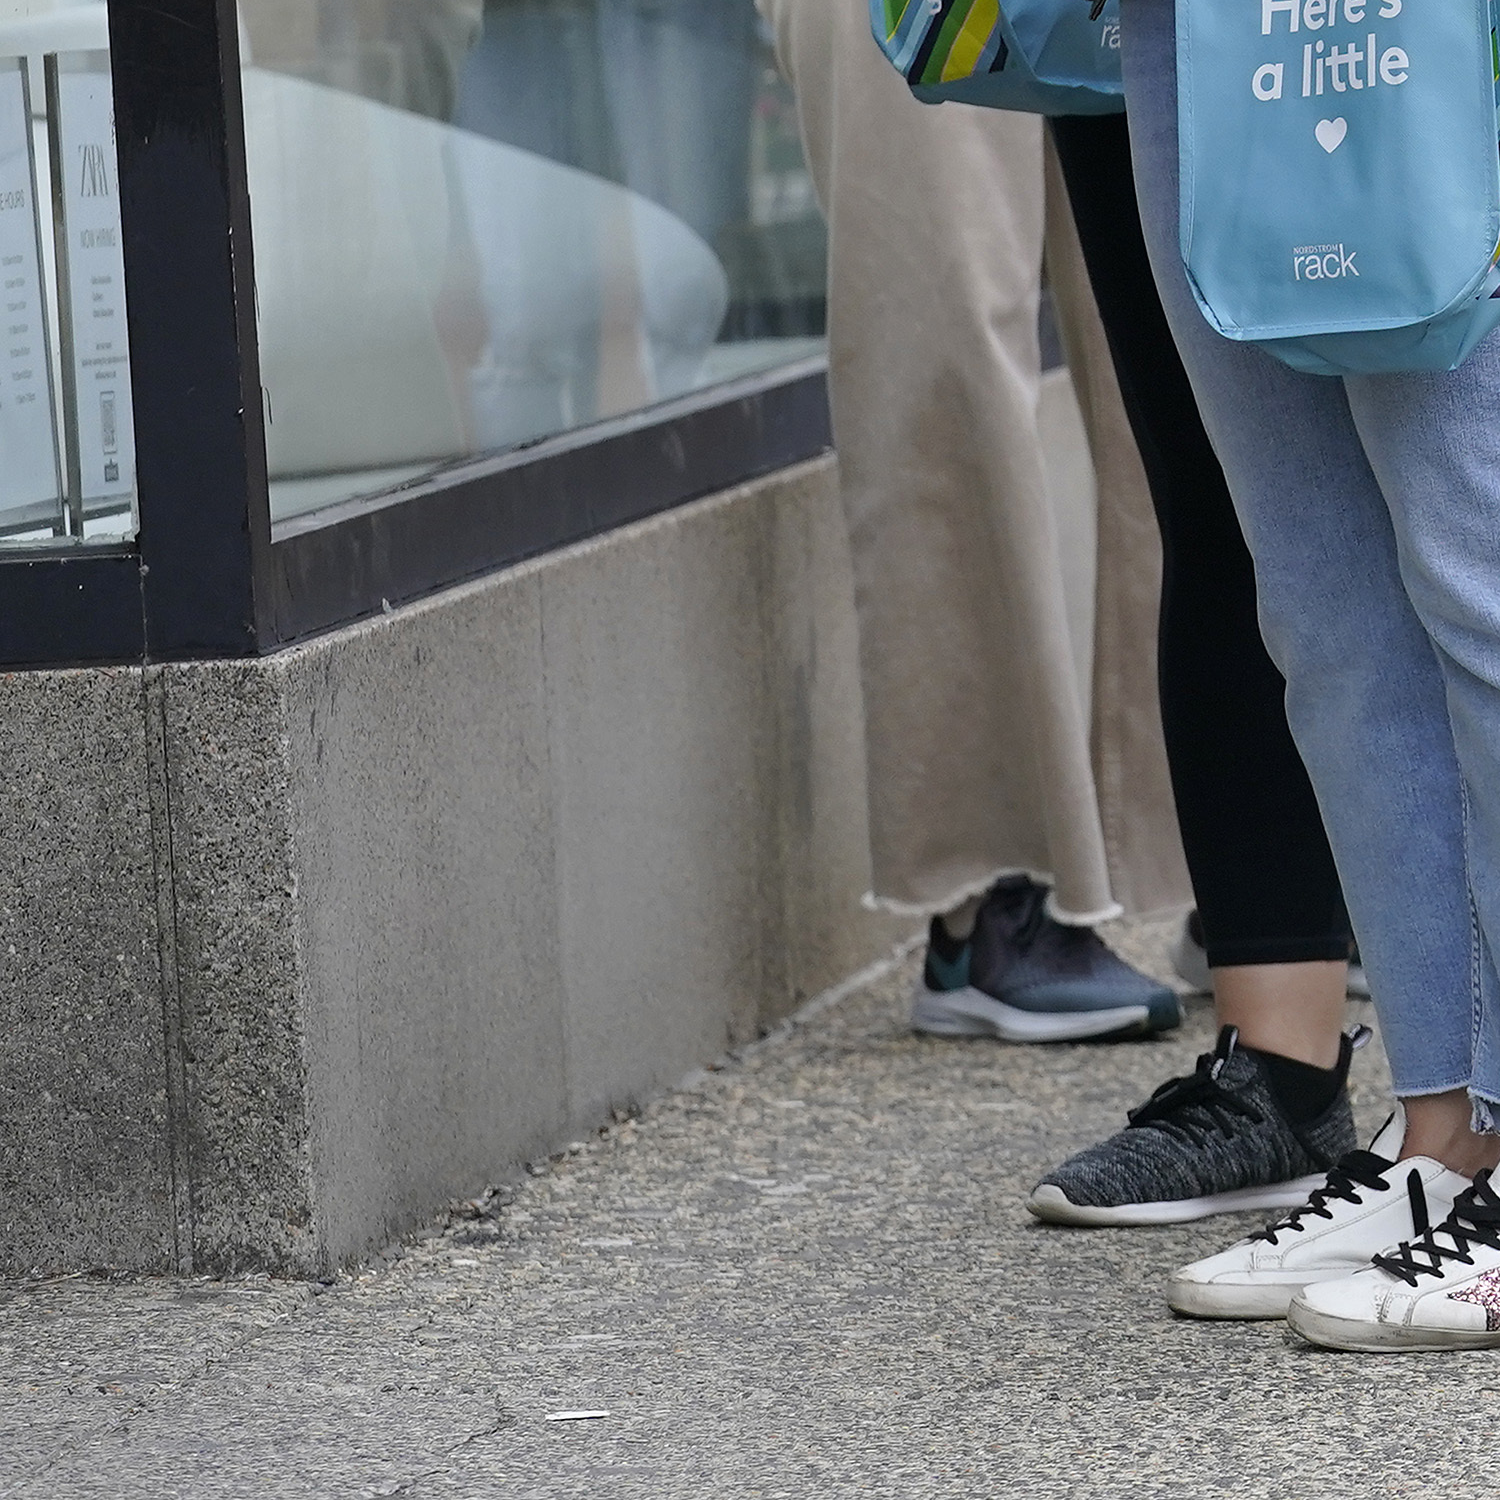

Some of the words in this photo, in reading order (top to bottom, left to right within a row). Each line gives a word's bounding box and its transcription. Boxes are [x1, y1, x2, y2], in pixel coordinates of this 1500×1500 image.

[1251, 62, 1283, 101] a
[1302, 34, 1409, 97] little
[1293, 243, 1339, 255] NORDSTROM
[1293, 243, 1360, 281] rack
